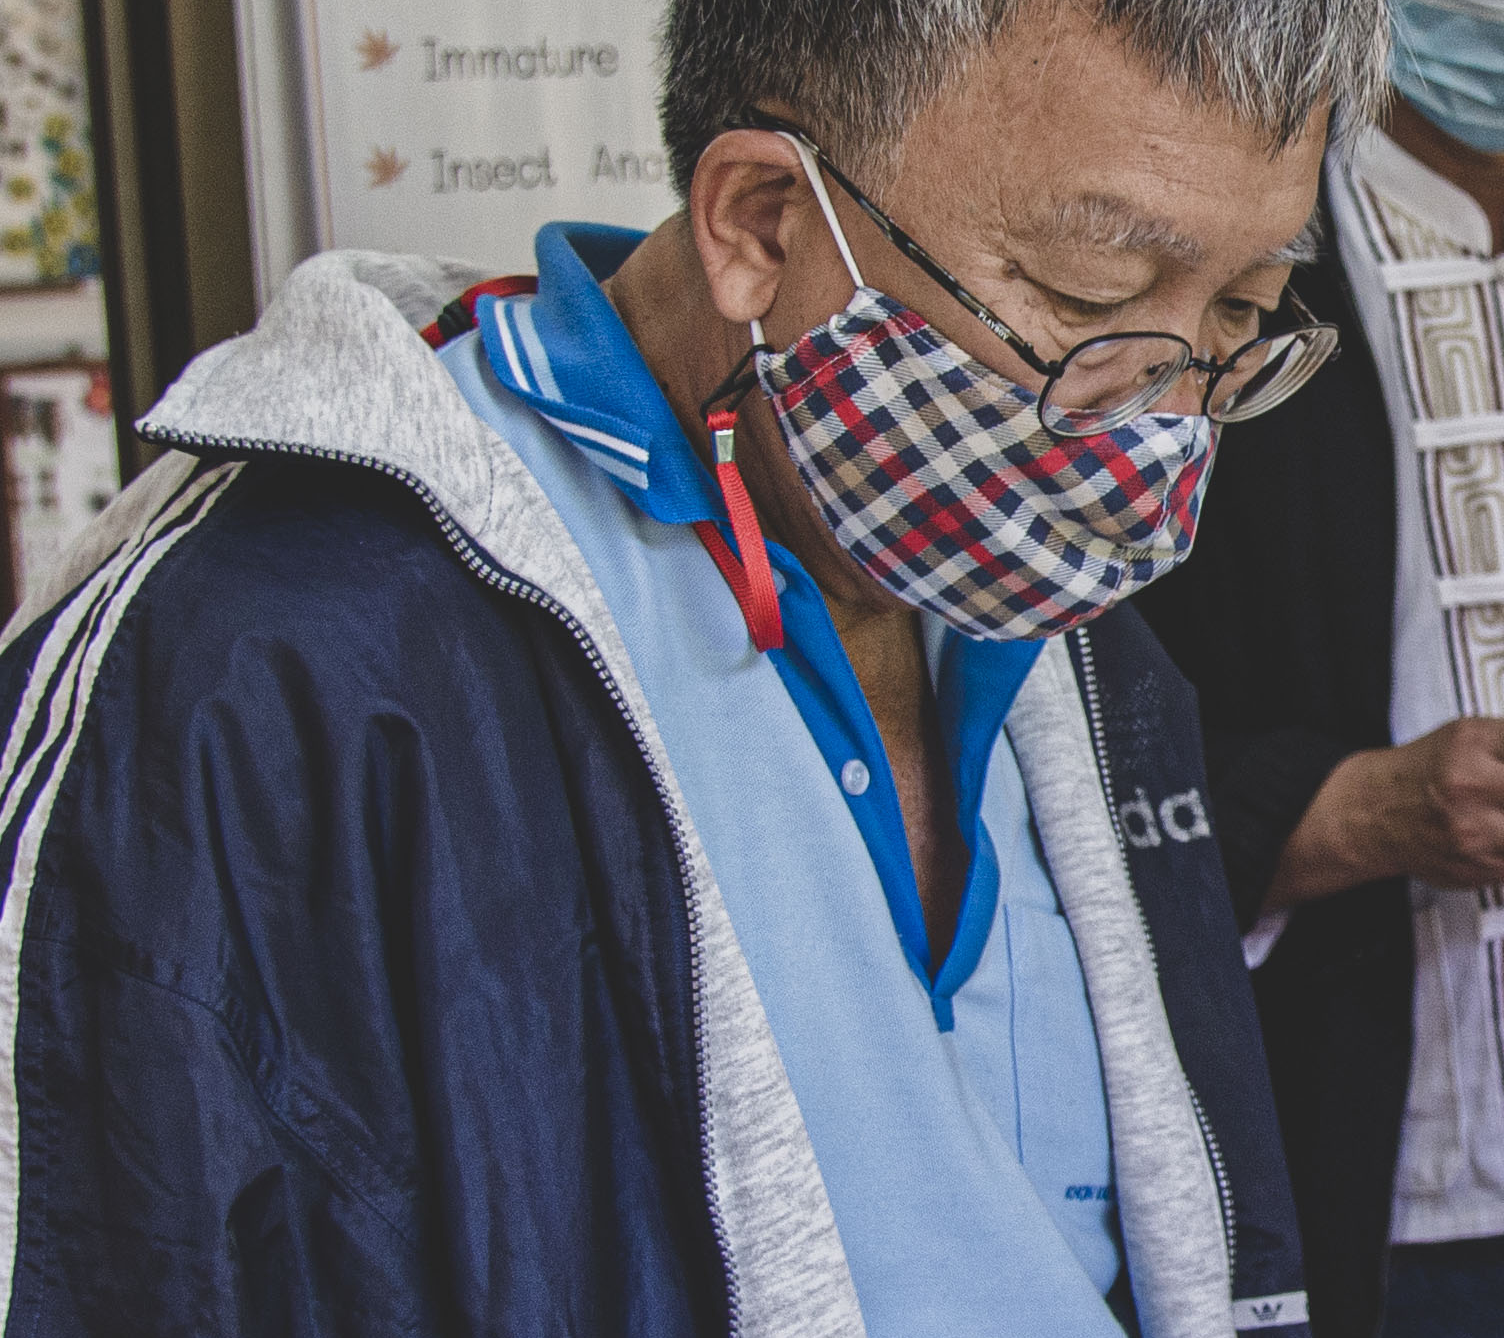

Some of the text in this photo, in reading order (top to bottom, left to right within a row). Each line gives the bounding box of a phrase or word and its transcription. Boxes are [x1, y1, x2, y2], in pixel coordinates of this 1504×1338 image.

[421, 34, 620, 83] Immature
[430, 143, 666, 192] Insect Ana
